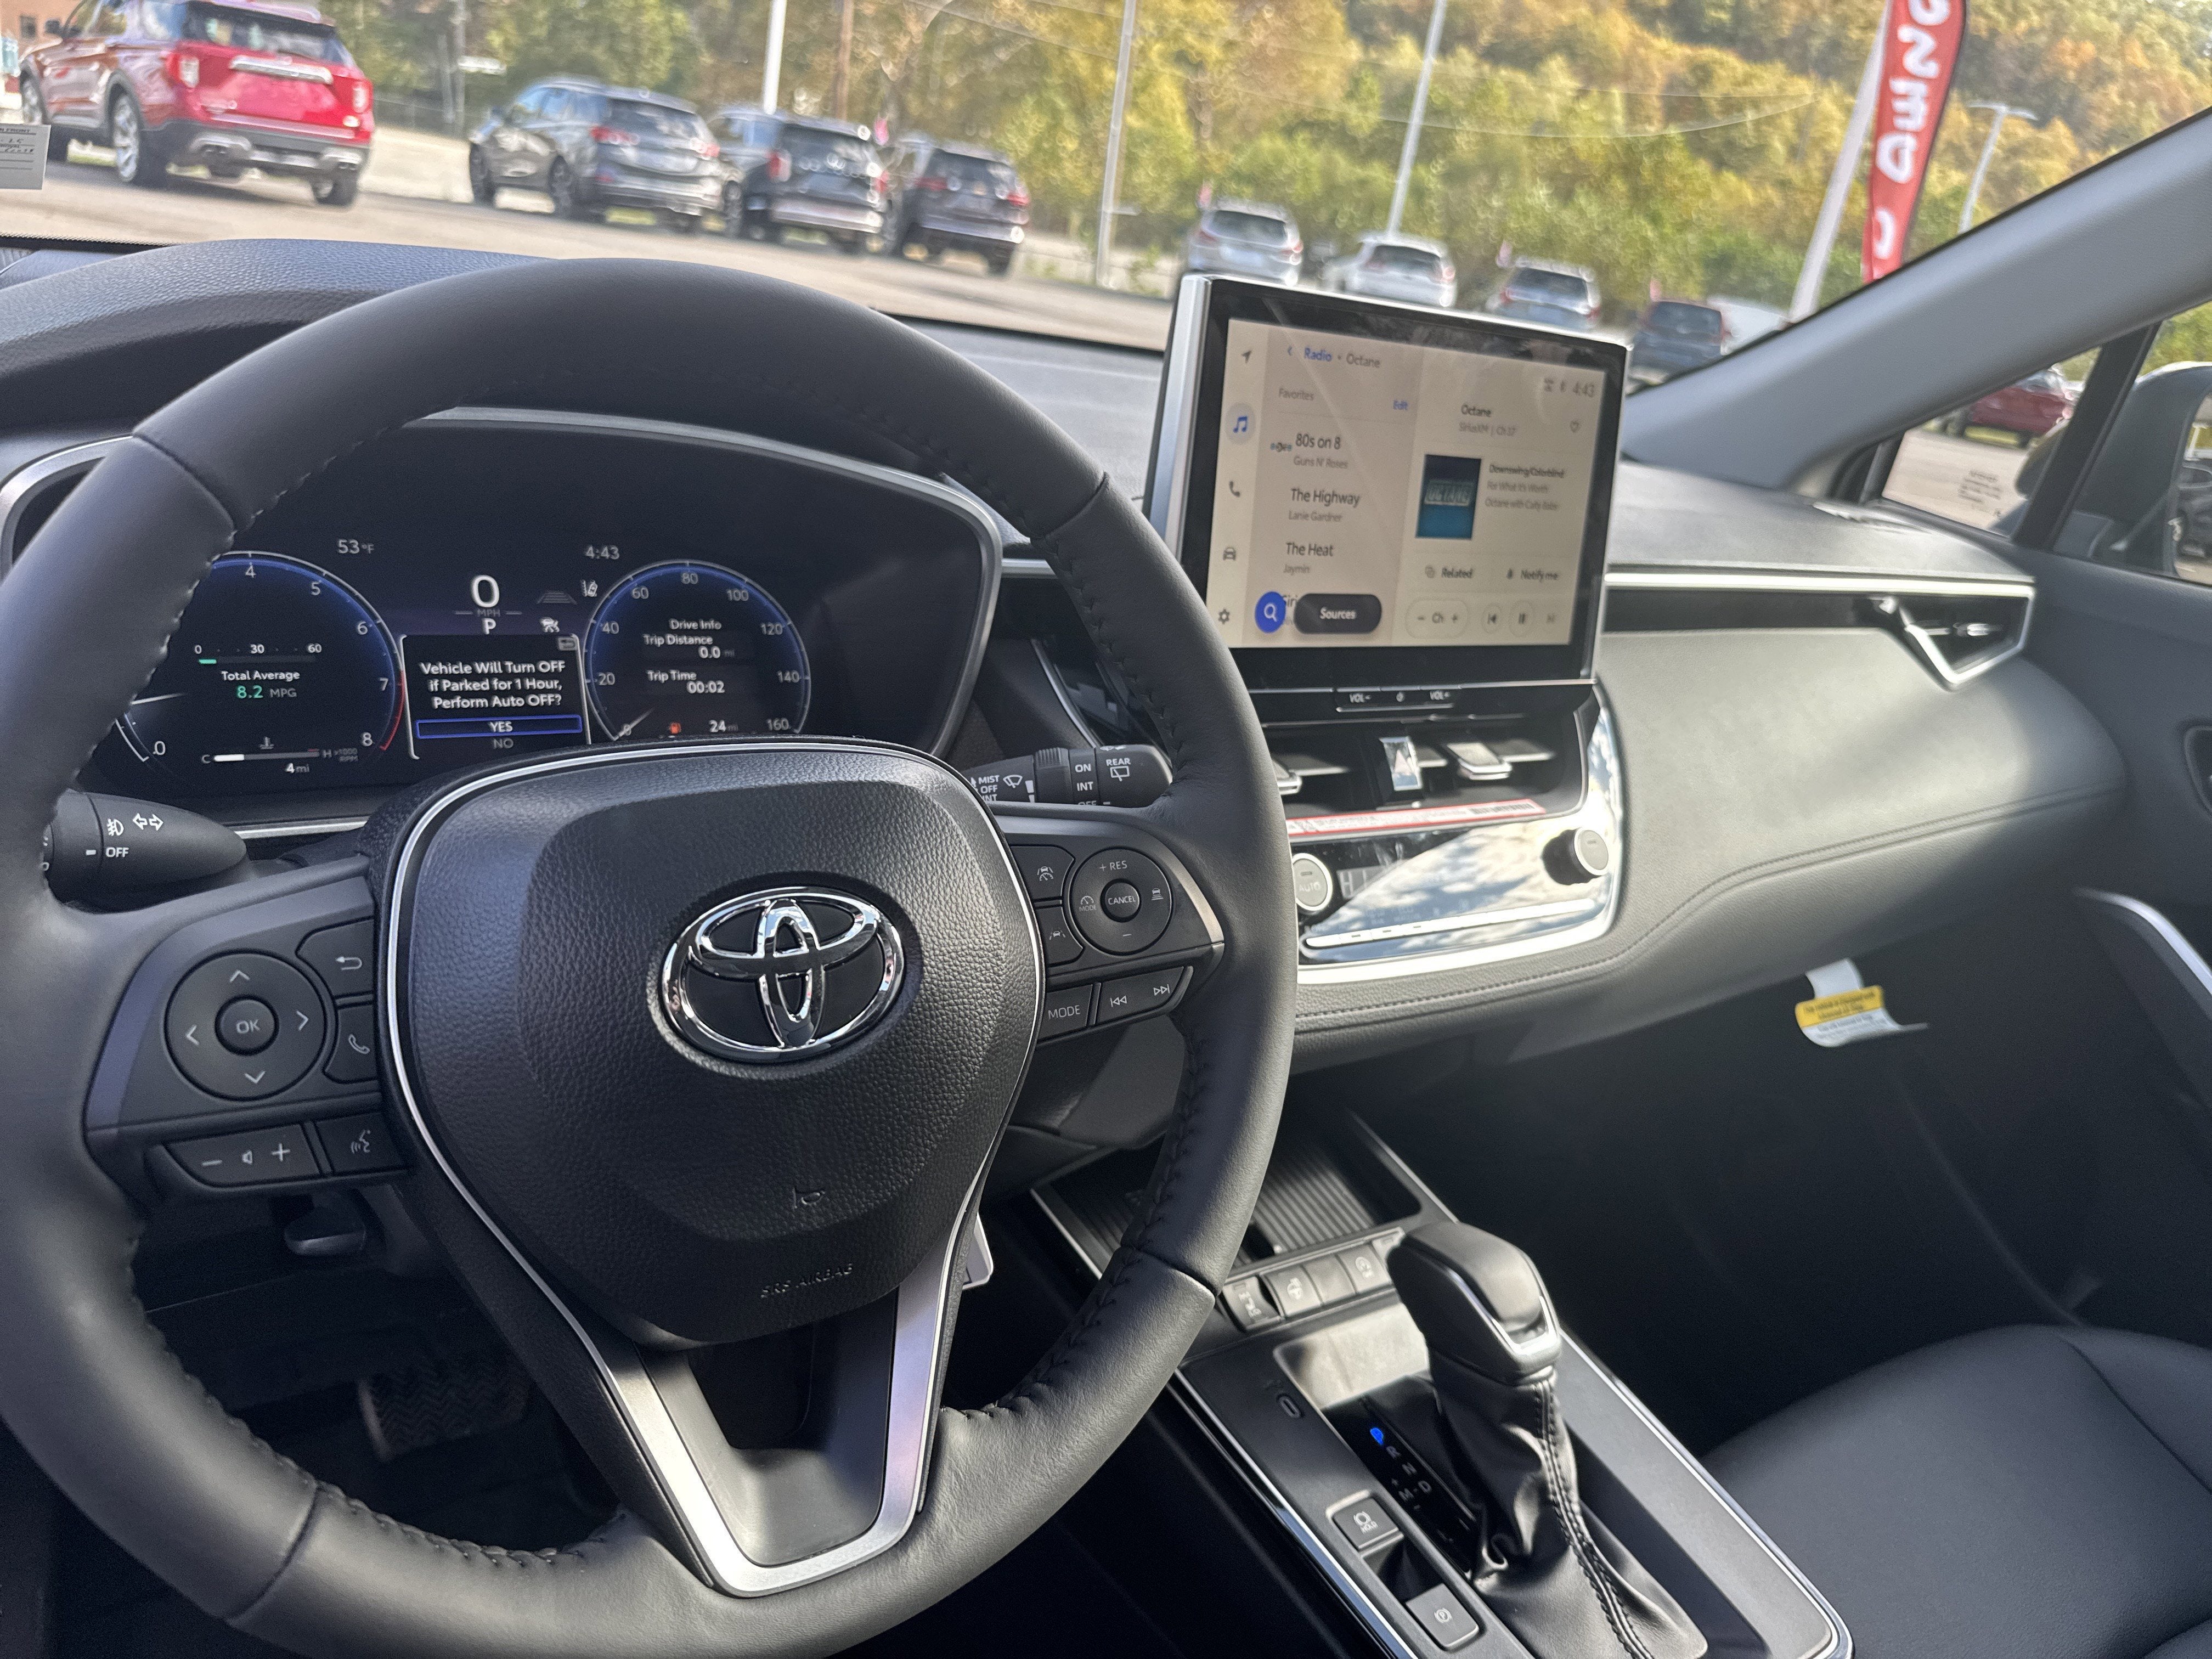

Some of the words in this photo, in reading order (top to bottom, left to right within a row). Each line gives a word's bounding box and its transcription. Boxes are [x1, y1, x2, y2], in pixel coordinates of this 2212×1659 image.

[1304, 347, 1333, 362] Radio
[1346, 353, 1381, 369] Octane
[1278, 388, 1315, 401] Favorites
[1393, 399, 1409, 411] Edit
[1461, 404, 1492, 417] Octane
[1295, 432, 1315, 448] 80s
[1317, 437, 1332, 449] on
[1334, 436, 1341, 450] 8
[1294, 455, 1314, 467] Guns
[1325, 458, 1348, 470] Roses
[1290, 488, 1311, 503] The
[1313, 489, 1361, 508] Highway
[337, 539, 360, 554] 53
[584, 545, 620, 560] 4:43
[1285, 542, 1305, 556] The
[1308, 543, 1334, 556] Heat
[245, 566, 256, 578] 4
[681, 572, 698, 585] 80
[1441, 567, 1474, 579] Related
[311, 582, 321, 596] 5
[471, 575, 500, 608] 0
[631, 587, 649, 600] 60
[727, 590, 749, 602] 100
[1319, 607, 1357, 620] Sources
[357, 622, 368, 635] 6
[484, 618, 496, 635] P
[602, 622, 620, 635] 40
[669, 619, 698, 630] Drive
[700, 619, 722, 630] Info
[761, 624, 783, 636] 120
[643, 635, 665, 647] Trip
[667, 634, 713, 645] Distance
[194, 644, 202, 654] 0
[250, 644, 265, 654] 30
[308, 644, 323, 653] 60
[698, 647, 721, 659] 0.0
[420, 662, 473, 675] Vehicle
[475, 662, 503, 674] Will
[504, 661, 535, 673] Turn
[538, 660, 566, 673] OFF
[221, 670, 251, 680] Total
[252, 670, 301, 682] Average
[597, 673, 616, 686] 20
[647, 670, 668, 682] Trip
[670, 670, 697, 681] Time
[777, 671, 800, 683] 140
[379, 679, 389, 691] 7
[428, 679, 442, 692] if
[443, 678, 490, 692] Parked
[492, 678, 512, 690] for
[515, 678, 522, 690] 1
[526, 678, 563, 691] Hour,
[686, 681, 725, 694] 00:02
[236, 686, 264, 699] 8.2
[269, 687, 297, 698] MPG
[432, 696, 489, 709] Perform
[492, 696, 525, 707] Auto
[526, 693, 562, 706] OFF?
[489, 721, 514, 733] YES
[709, 720, 726, 733] 24
[768, 719, 789, 731] 160
[361, 732, 374, 747] 8
[493, 738, 514, 749] NO
[154, 741, 166, 755] 0
[286, 763, 295, 774] 4
[1075, 763, 1092, 773] ON
[1106, 758, 1131, 766] REAR
[978, 775, 1000, 785] MIST
[1076, 781, 1094, 792] INT
[980, 785, 998, 794] OFF
[105, 847, 129, 858] OFF
[1109, 860, 1128, 871] RES
[1299, 881, 1322, 893] AUTO
[1107, 895, 1136, 906] CANCEL
[1079, 904, 1097, 912] MODE
[1048, 1005, 1081, 1020] MODE
[235, 1019, 261, 1035] OK
